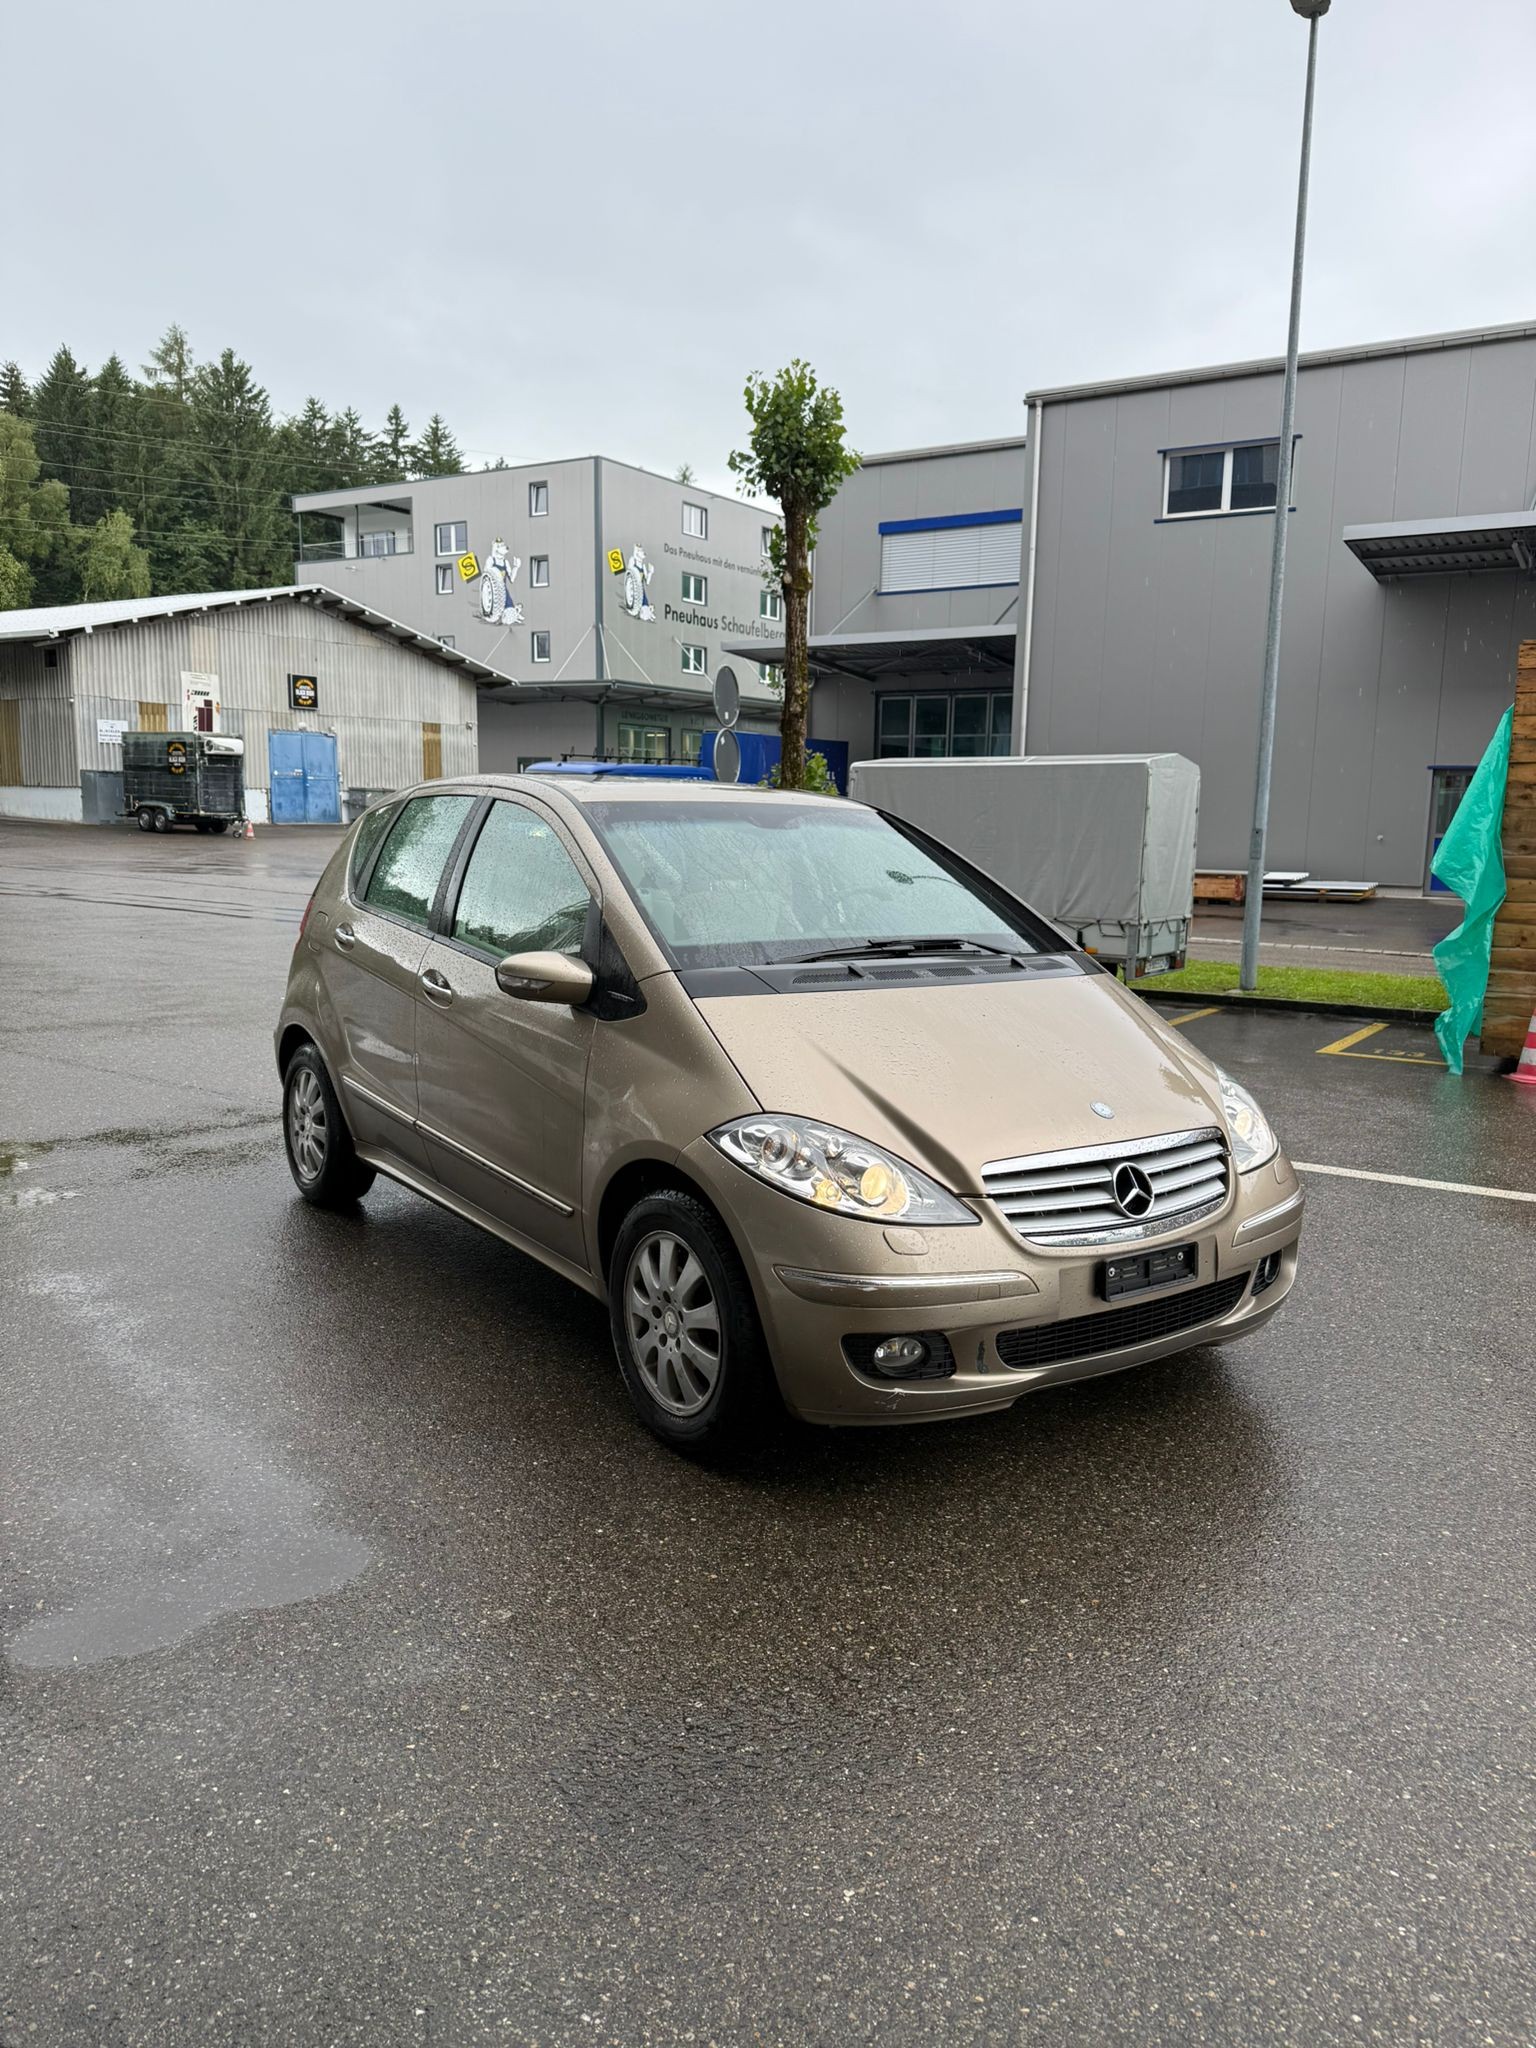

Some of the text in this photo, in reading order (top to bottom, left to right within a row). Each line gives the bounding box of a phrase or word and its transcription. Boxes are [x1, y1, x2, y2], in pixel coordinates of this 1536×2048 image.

[664, 543, 677, 555] Das
[679, 547, 711, 564] Pneuhaus
[712, 556, 722, 567] mit
[724, 558, 735, 570] den
[665, 604, 718, 630] Pneuhaus
